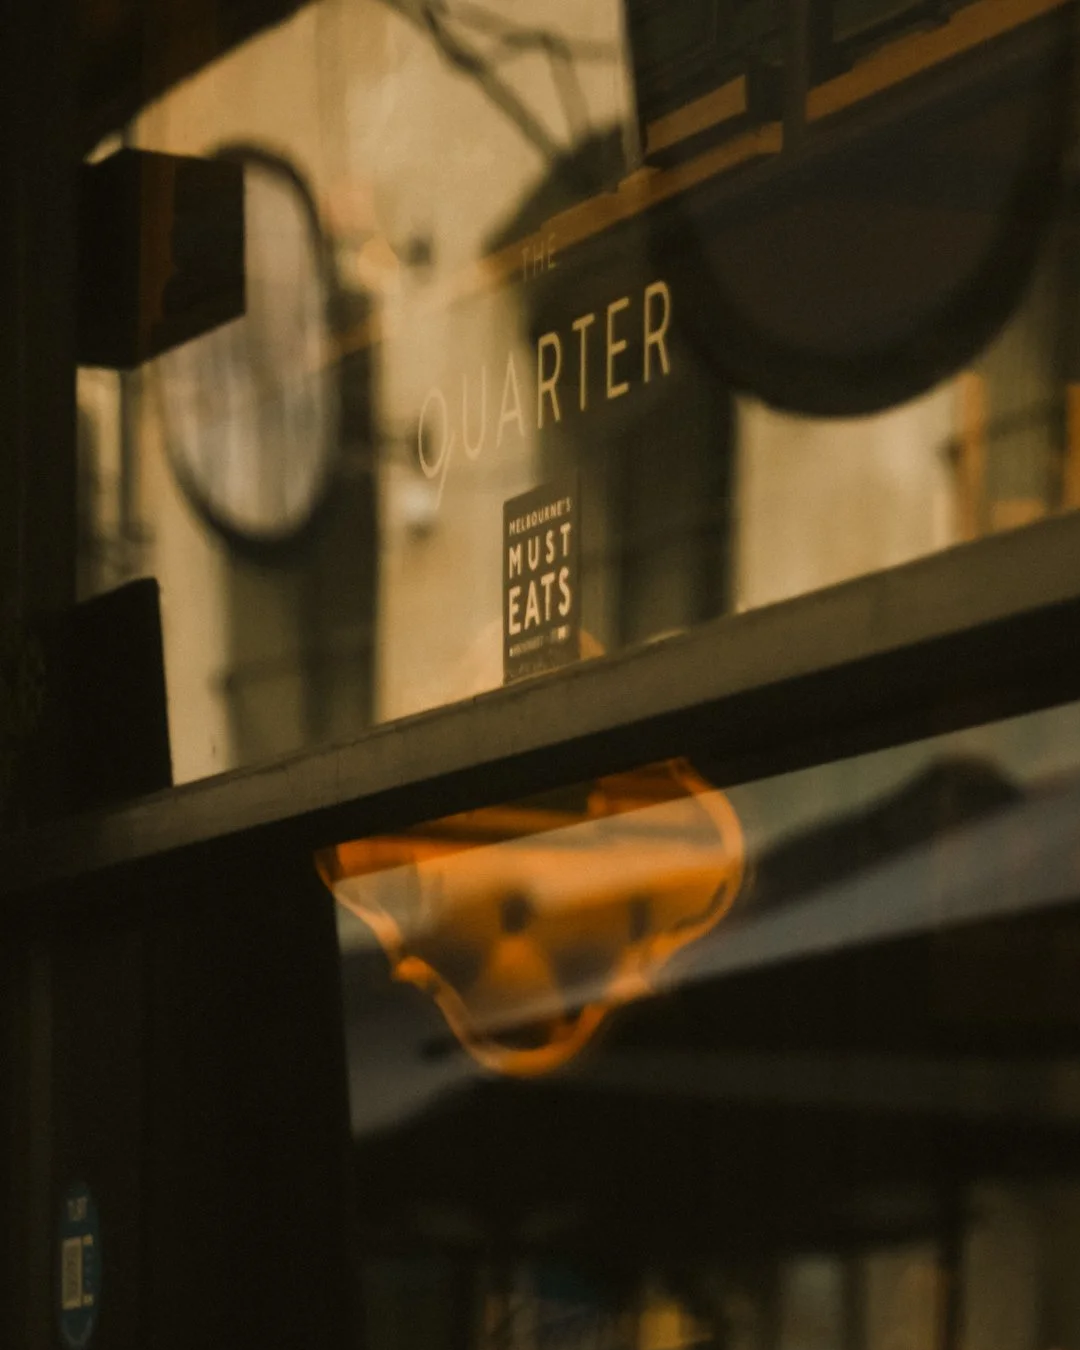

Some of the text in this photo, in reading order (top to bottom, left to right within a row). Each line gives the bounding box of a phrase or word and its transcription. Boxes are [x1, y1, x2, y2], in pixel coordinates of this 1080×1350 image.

[520, 231, 557, 283] THE
[417, 280, 672, 512] QUARTER
[508, 521, 572, 580] MUST
[508, 566, 572, 636] EATS
